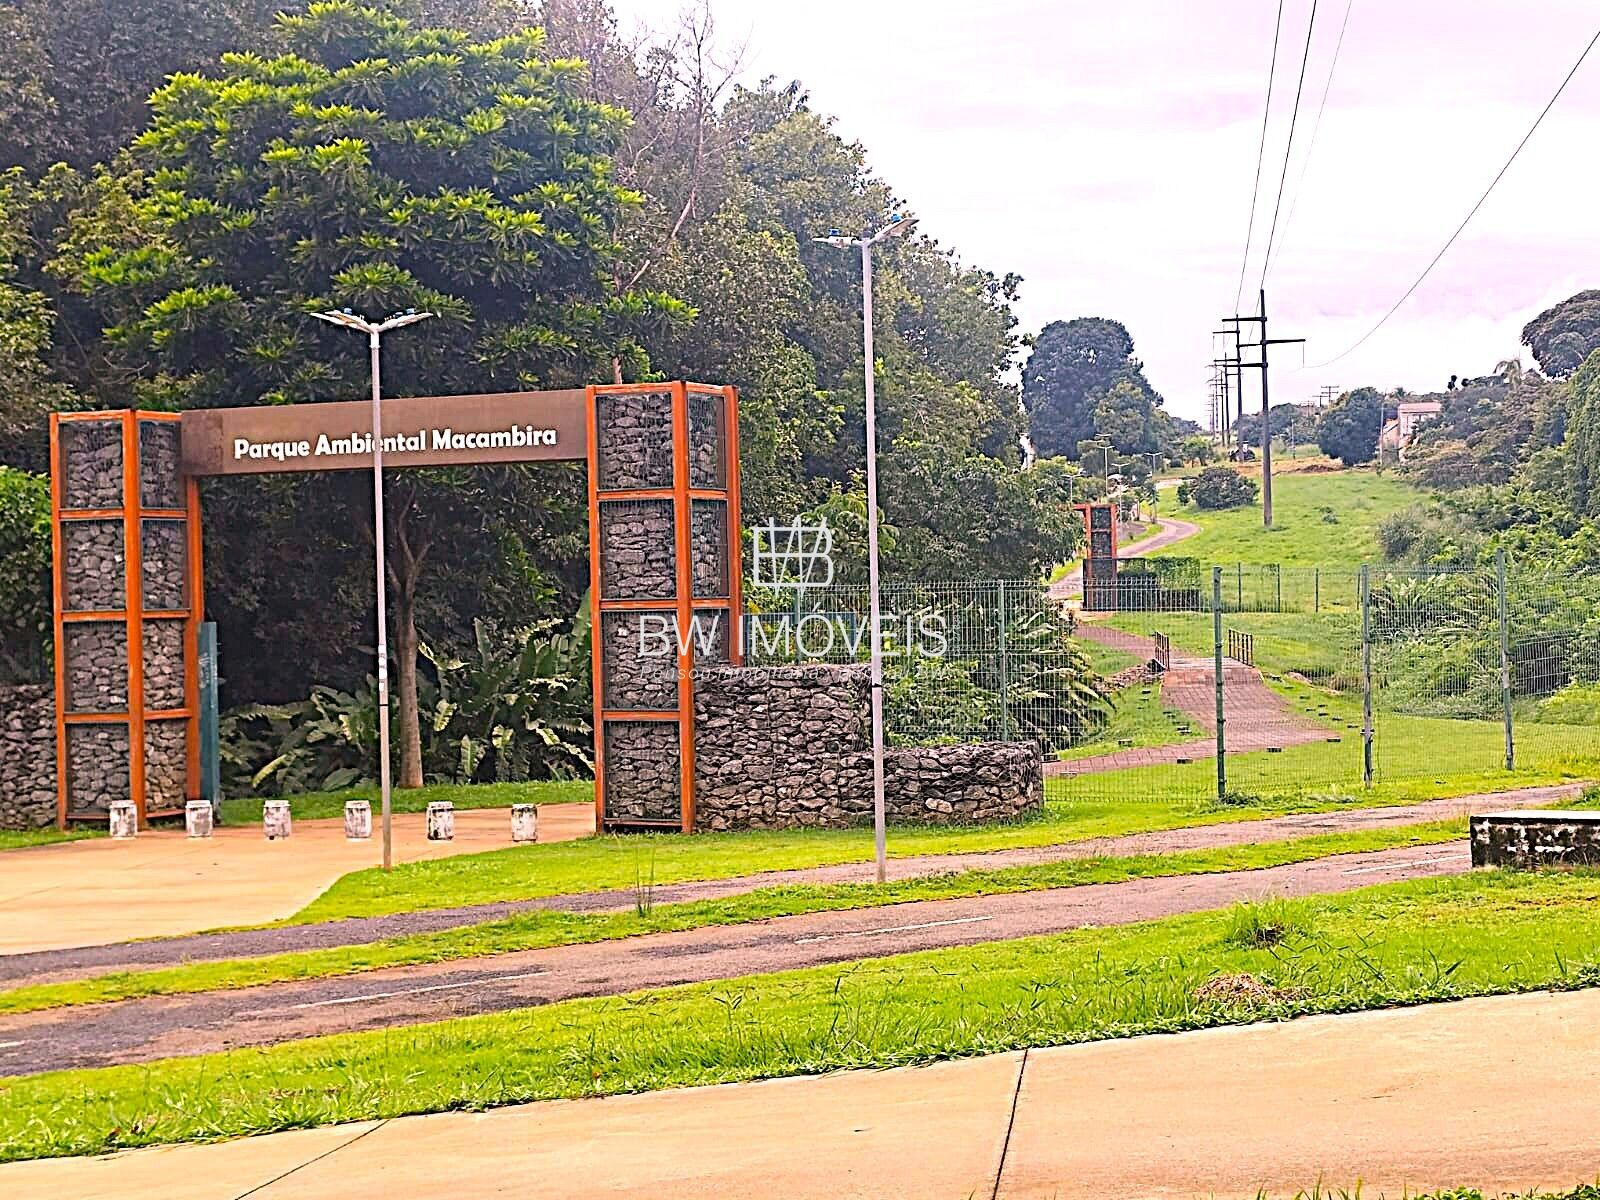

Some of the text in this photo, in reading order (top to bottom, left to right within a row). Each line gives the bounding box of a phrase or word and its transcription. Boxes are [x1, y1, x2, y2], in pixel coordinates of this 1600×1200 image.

[234, 425, 557, 461] Parque Ambiental Macambira
